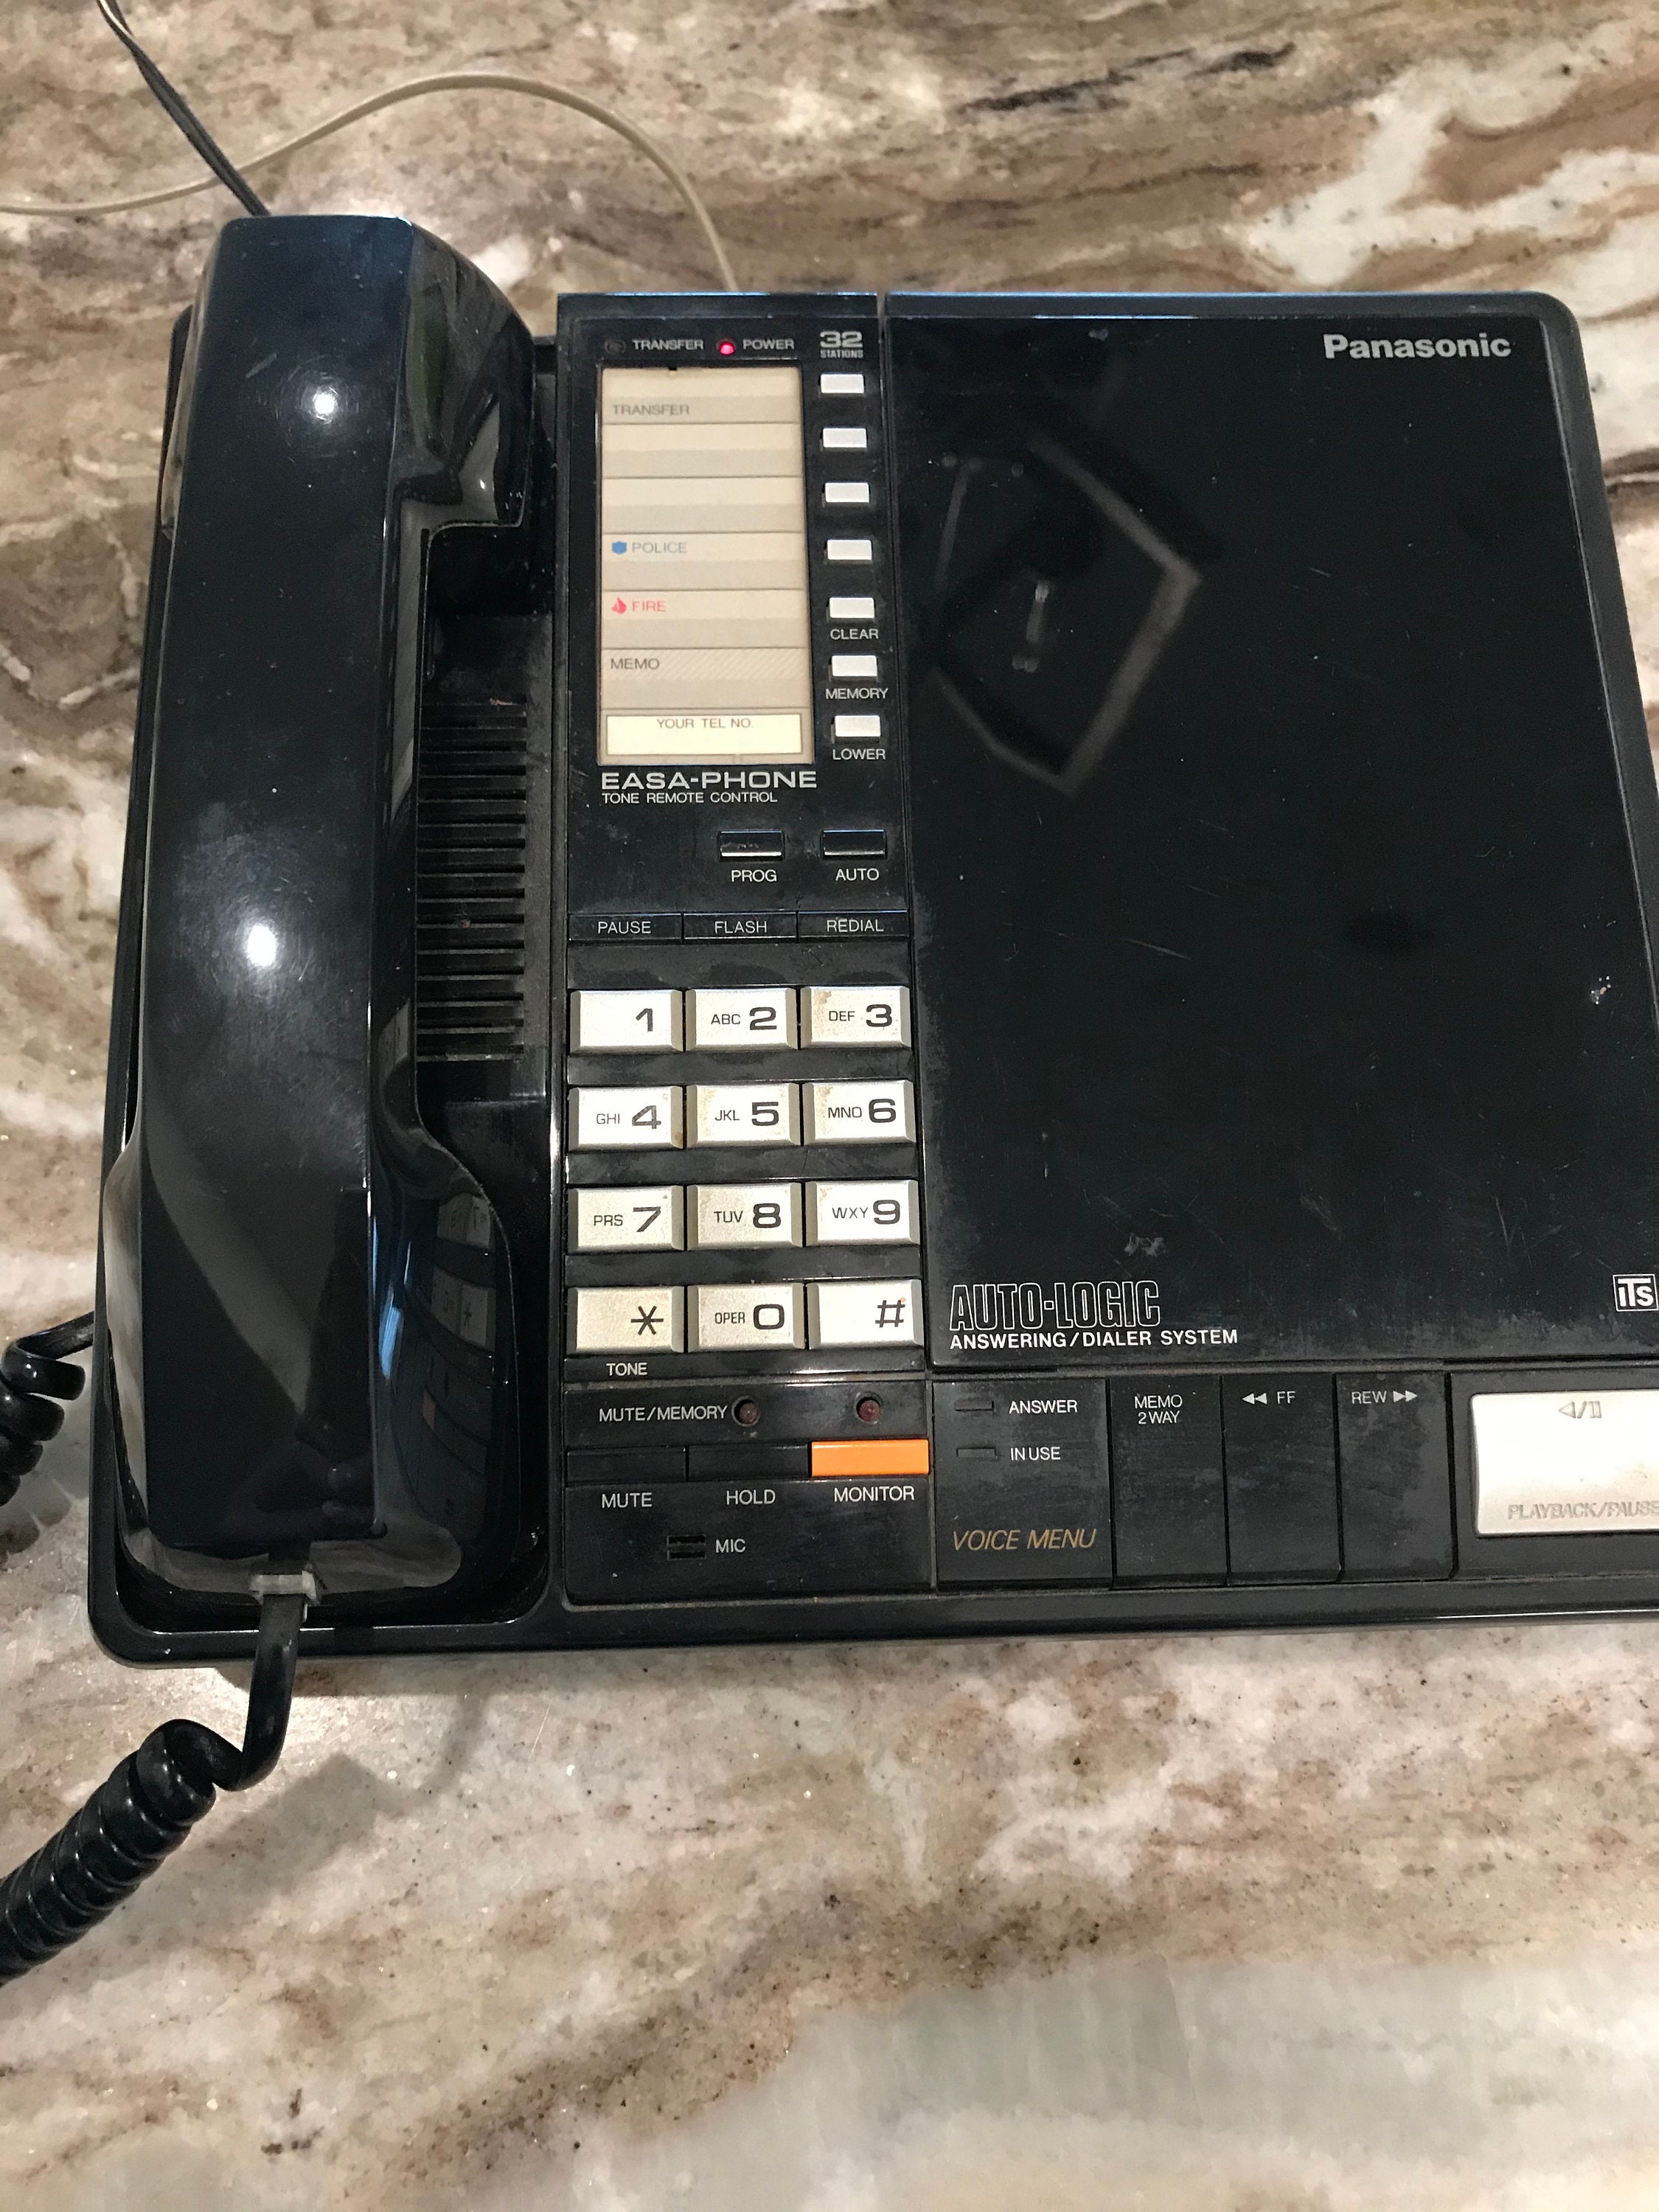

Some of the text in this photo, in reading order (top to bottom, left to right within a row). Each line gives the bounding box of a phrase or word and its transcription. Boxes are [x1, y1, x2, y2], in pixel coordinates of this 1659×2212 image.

[633, 339, 703, 351] TRANSFER
[743, 339, 795, 350] POWER
[820, 331, 863, 347] 32
[1323, 332, 1512, 359] Panasonic
[820, 349, 863, 358] STATIONS
[613, 404, 689, 416] TRANSFER
[631, 542, 687, 554] POLICE
[632, 601, 666, 612] FIRE
[830, 629, 879, 640] CLEAR
[611, 658, 660, 670] MEMO
[826, 688, 888, 700] MEMORY
[657, 717, 754, 728] YOUR TEL NO.
[832, 748, 886, 761] LOWER
[602, 771, 817, 790] EASA-PHONE
[602, 792, 778, 804] TONE REMOTE CONTROL
[731, 870, 777, 883] PROG
[835, 869, 880, 882] AUTO
[597, 922, 651, 934] PAUSE
[714, 921, 767, 933] FLASH
[827, 919, 884, 932] REDIAL
[636, 1008, 653, 1032] 1
[711, 1007, 777, 1031] ABC 2
[829, 1004, 892, 1027] DEF 3
[596, 1105, 661, 1130] GHI 4
[715, 1102, 779, 1127] JKL 5
[828, 1098, 897, 1124] MNO 6
[594, 1206, 661, 1233] PRS 7
[714, 1203, 782, 1228] TUV 8
[832, 1200, 901, 1225] WXY 9
[950, 1280, 1161, 1331] AUTO-LOGIC
[714, 1311, 745, 1325] OPER
[875, 1299, 905, 1328] #
[950, 1329, 1237, 1350] ANSWERING/DIALER SYSTEM
[606, 1363, 647, 1375] TONE
[1134, 1395, 1183, 1409] MEMO
[1277, 1391, 1295, 1404] FF
[1352, 1391, 1387, 1404] REW
[599, 1405, 727, 1422] MUTE/MEMORY
[1009, 1400, 1078, 1414] ANSWER
[602, 1492, 653, 1508] MUTE
[726, 1490, 776, 1505] HOLD
[835, 1486, 915, 1502] MONITOR
[953, 1528, 1096, 1551] VOICE MENU
[715, 1540, 745, 1554] MIC
